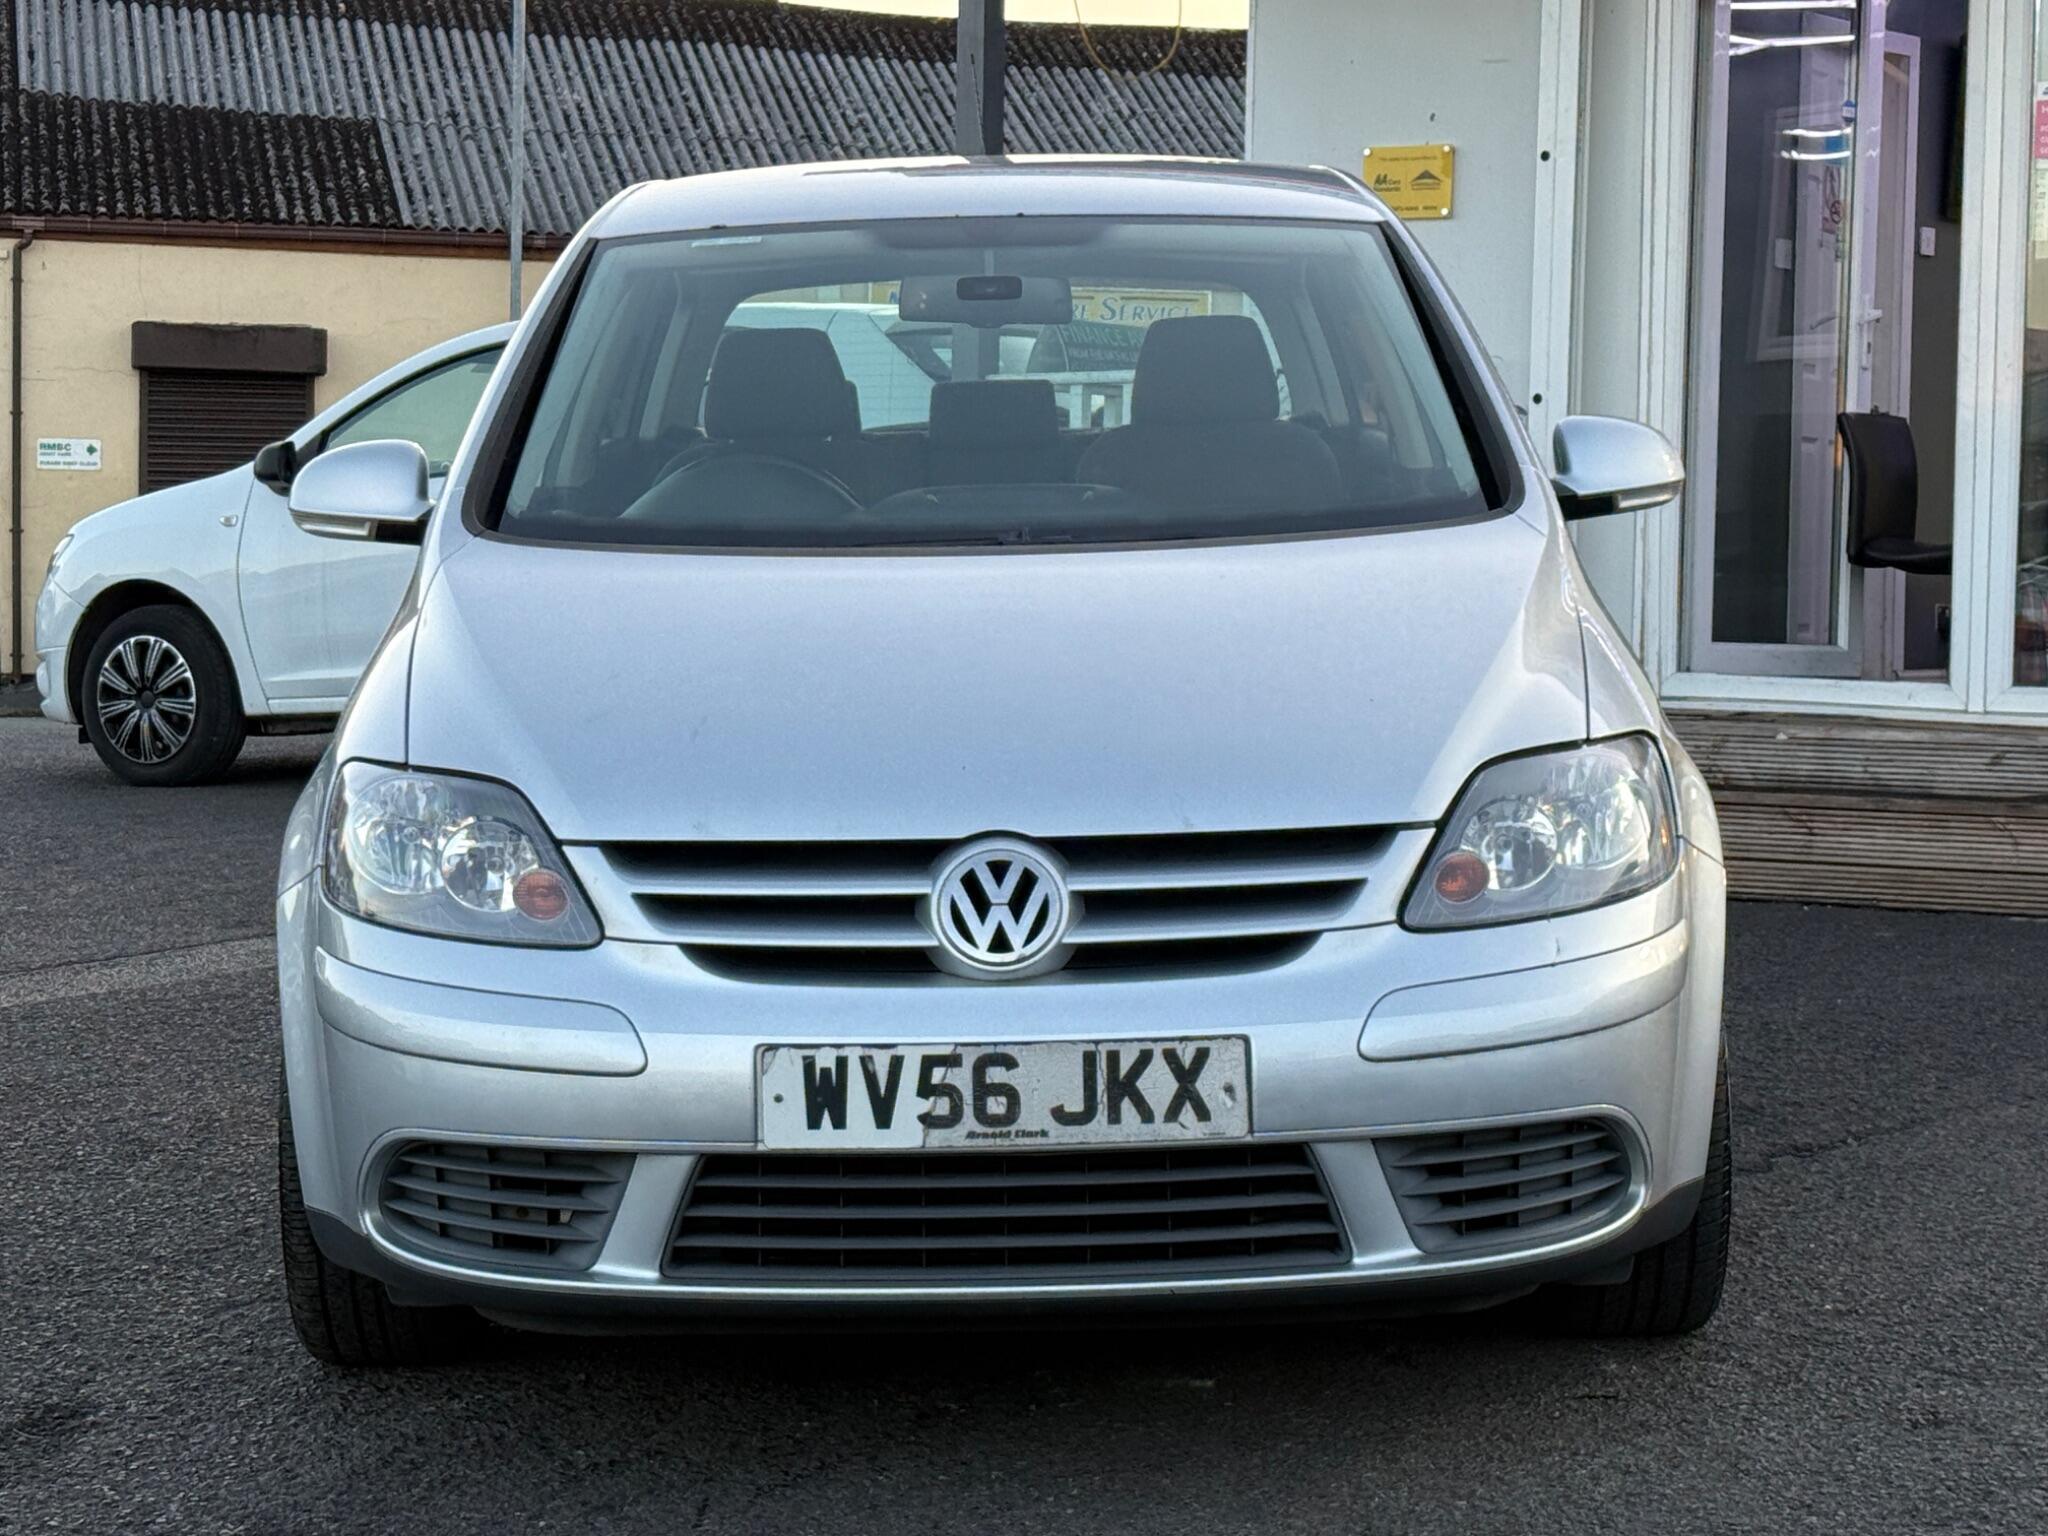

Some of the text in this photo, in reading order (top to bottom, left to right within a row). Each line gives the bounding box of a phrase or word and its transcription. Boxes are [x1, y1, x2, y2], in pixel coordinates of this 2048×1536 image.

[801, 1047, 1212, 1130] WV56 JKX
[965, 1129, 1050, 1140] Arnold Clark
